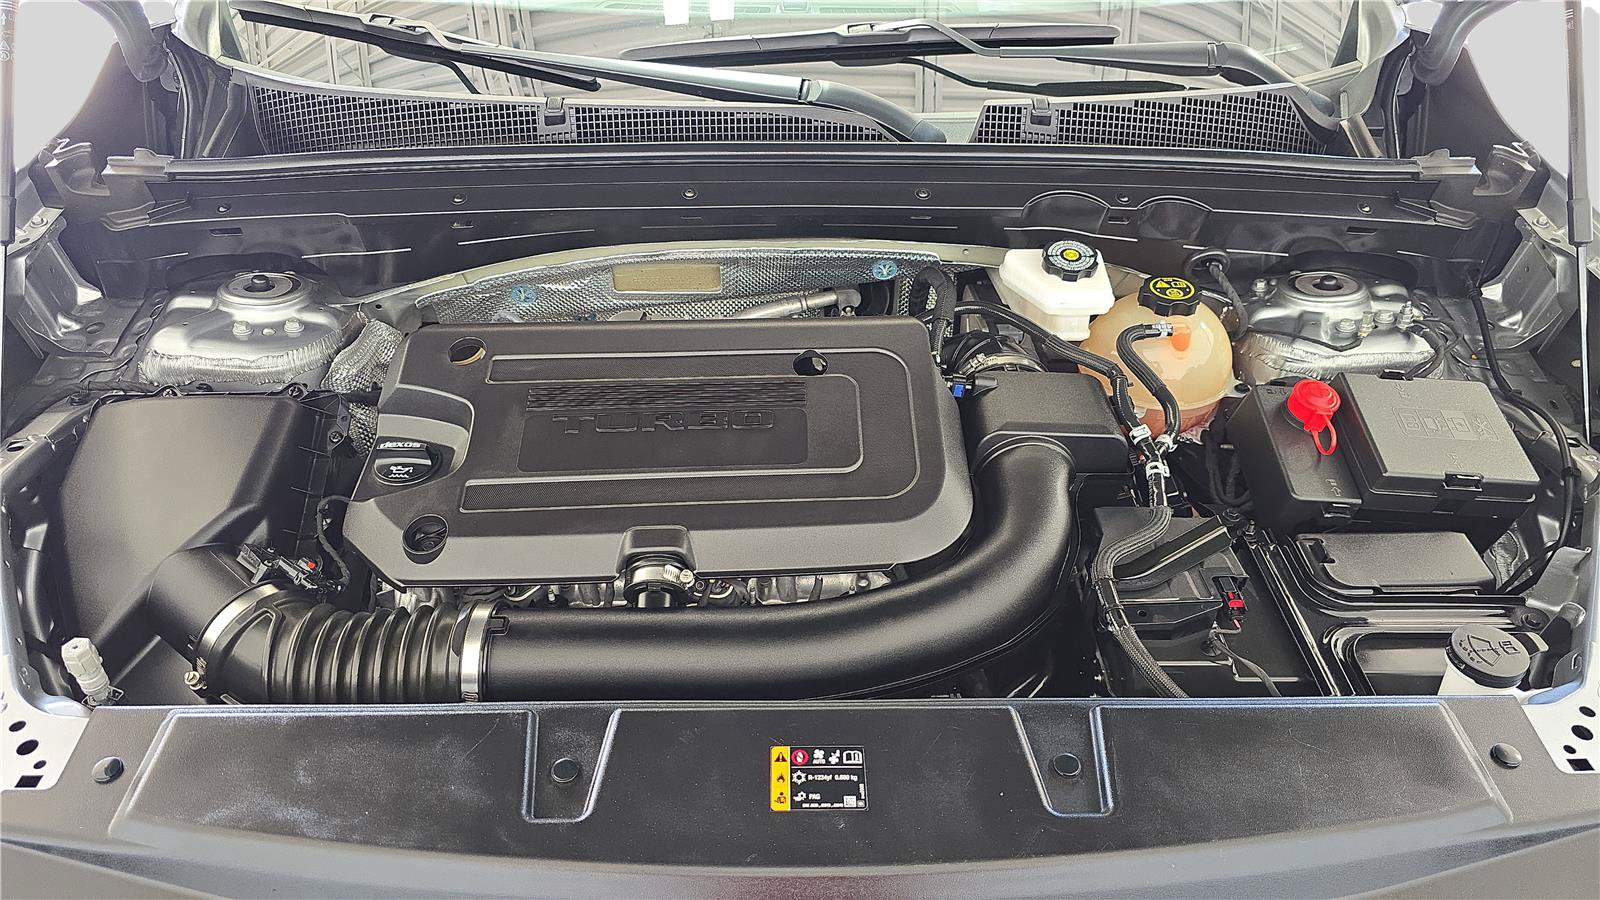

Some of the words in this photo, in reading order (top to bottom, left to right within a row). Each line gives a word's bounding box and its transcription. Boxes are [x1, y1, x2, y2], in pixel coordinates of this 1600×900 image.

[552, 409, 775, 434] TURBO
[379, 441, 422, 449] dexos
[808, 774, 833, 782] R-1234yf
[851, 774, 858, 782] kg
